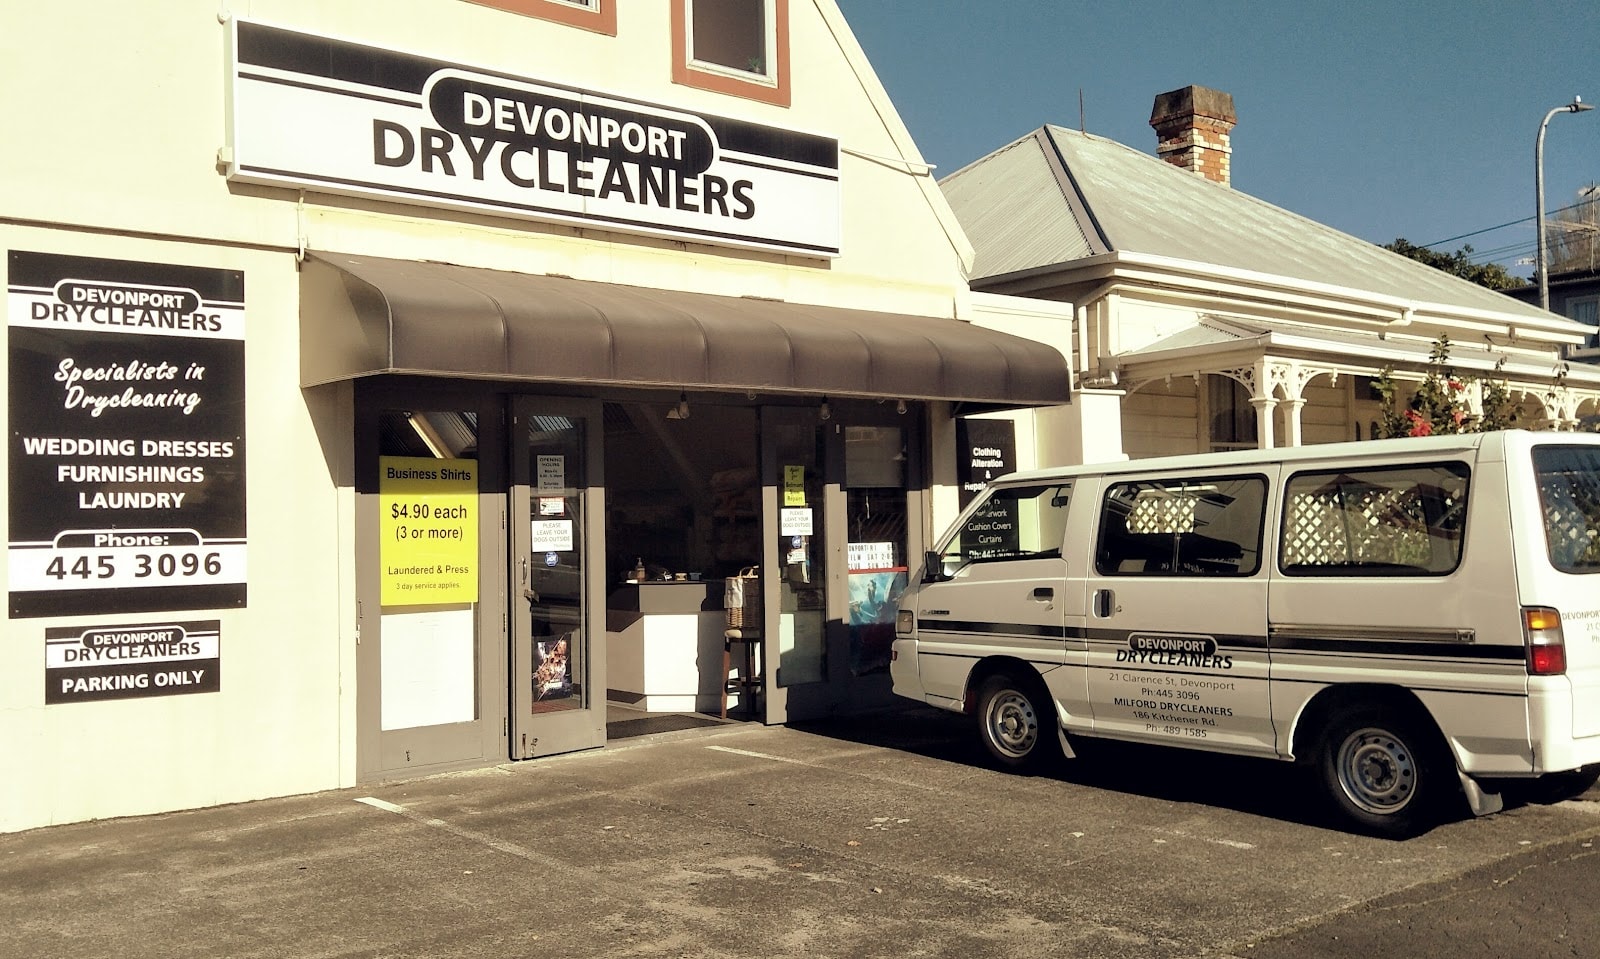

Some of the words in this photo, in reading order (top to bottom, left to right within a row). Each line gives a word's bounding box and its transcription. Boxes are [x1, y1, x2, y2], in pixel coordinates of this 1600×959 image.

[462, 91, 688, 161] DEVONPORT
[372, 118, 756, 220] DRYCLEANERS
[72, 287, 185, 309] DEVONPORT
[31, 302, 222, 332] DRYCLEANERS
[54, 358, 179, 390] Specialists
[185, 362, 206, 381] in
[64, 385, 202, 418] Drycleaning
[23, 437, 136, 457] WEDDING
[142, 440, 234, 458] DRESSES
[973, 447, 1001, 458] Clothing
[971, 459, 1004, 468] Alteration
[57, 465, 205, 483] FURNISHINGS
[387, 467, 437, 480] Business
[440, 468, 472, 481] Shirts
[985, 470, 991, 479] &
[79, 492, 186, 510] LAUNDRY
[391, 503, 430, 519] $4.90
[434, 504, 467, 519] each
[395, 525, 408, 542] (3
[411, 529, 425, 539] or
[428, 526, 463, 541] more)
[967, 522, 991, 531] Cushion
[991, 521, 1012, 530] Covers
[94, 533, 170, 547] Phone:
[978, 534, 1003, 544] Curtains
[45, 555, 116, 580] 445
[134, 552, 222, 578] 3096
[388, 566, 434, 575] Laundered
[437, 566, 443, 574] &
[445, 565, 469, 574] Press
[396, 582, 401, 590] 3
[402, 582, 413, 591] day
[414, 582, 437, 590] service
[93, 631, 174, 645] DEVONPORT
[1137, 637, 1207, 653] DEVONPORT
[64, 641, 201, 662] DRYCLEANERS
[1116, 649, 1233, 669] DRYCLEANERS
[61, 673, 149, 693] PARKING
[154, 669, 205, 687] ONLY
[1109, 673, 1119, 681] 21
[1122, 673, 1163, 685] Clarence
[1165, 677, 1178, 687] St,
[1180, 678, 1235, 691] Devonport
[1141, 687, 1174, 699] Ph:445
[1176, 690, 1200, 701] 3096
[1114, 697, 1157, 709] MILFORD
[1160, 701, 1233, 717] DRYCLEANERS
[1133, 711, 1150, 720] 186
[1151, 712, 1199, 725] Kitchener
[1201, 717, 1220, 727] Rd.
[1146, 723, 1161, 732] Ph:
[1163, 725, 1181, 735] 489
[1184, 727, 1208, 738] 1585
